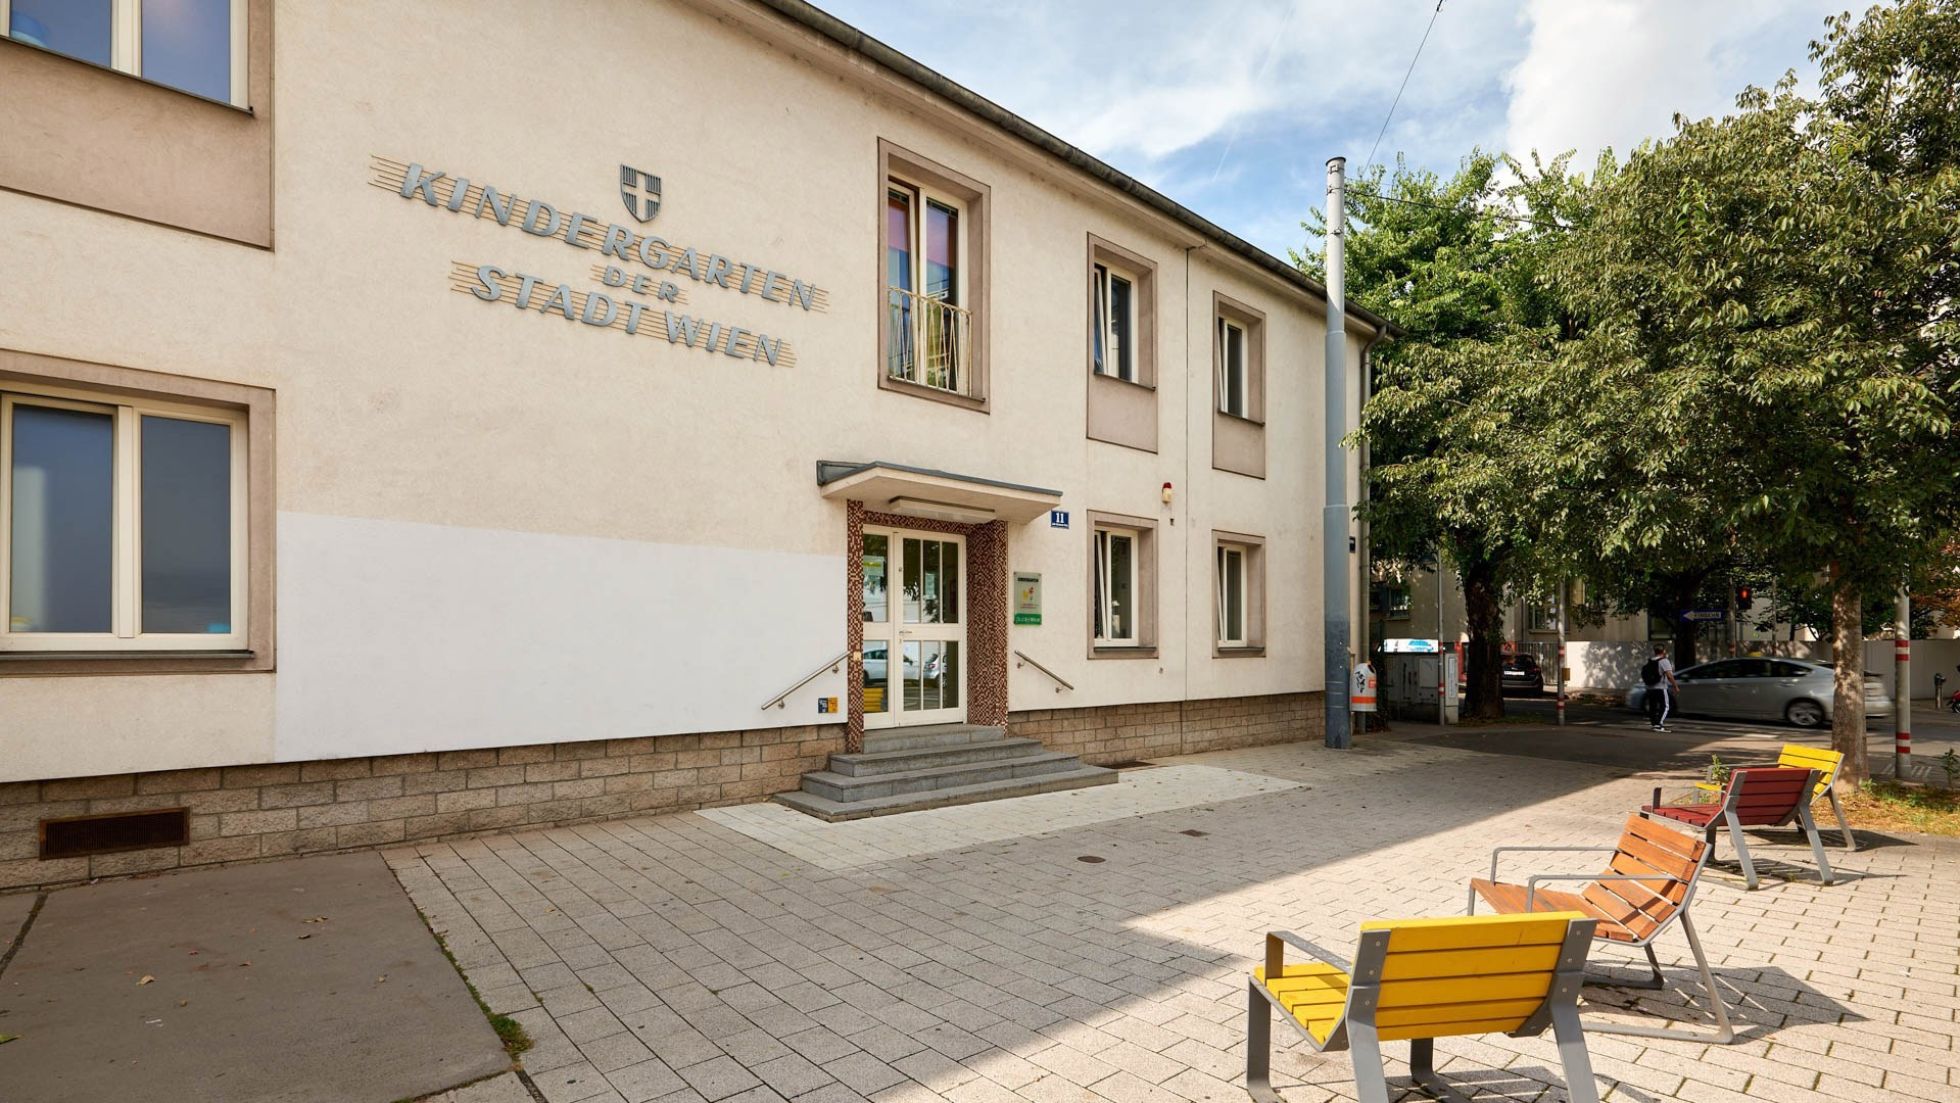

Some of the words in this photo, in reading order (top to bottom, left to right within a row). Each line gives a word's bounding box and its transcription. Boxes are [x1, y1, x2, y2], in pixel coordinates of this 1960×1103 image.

[400, 162, 816, 311] KINDERGARTEN
[471, 264, 651, 334] STADT
[665, 310, 782, 367] WIEN
[602, 265, 681, 302] DER
[1055, 512, 1065, 524] 11
